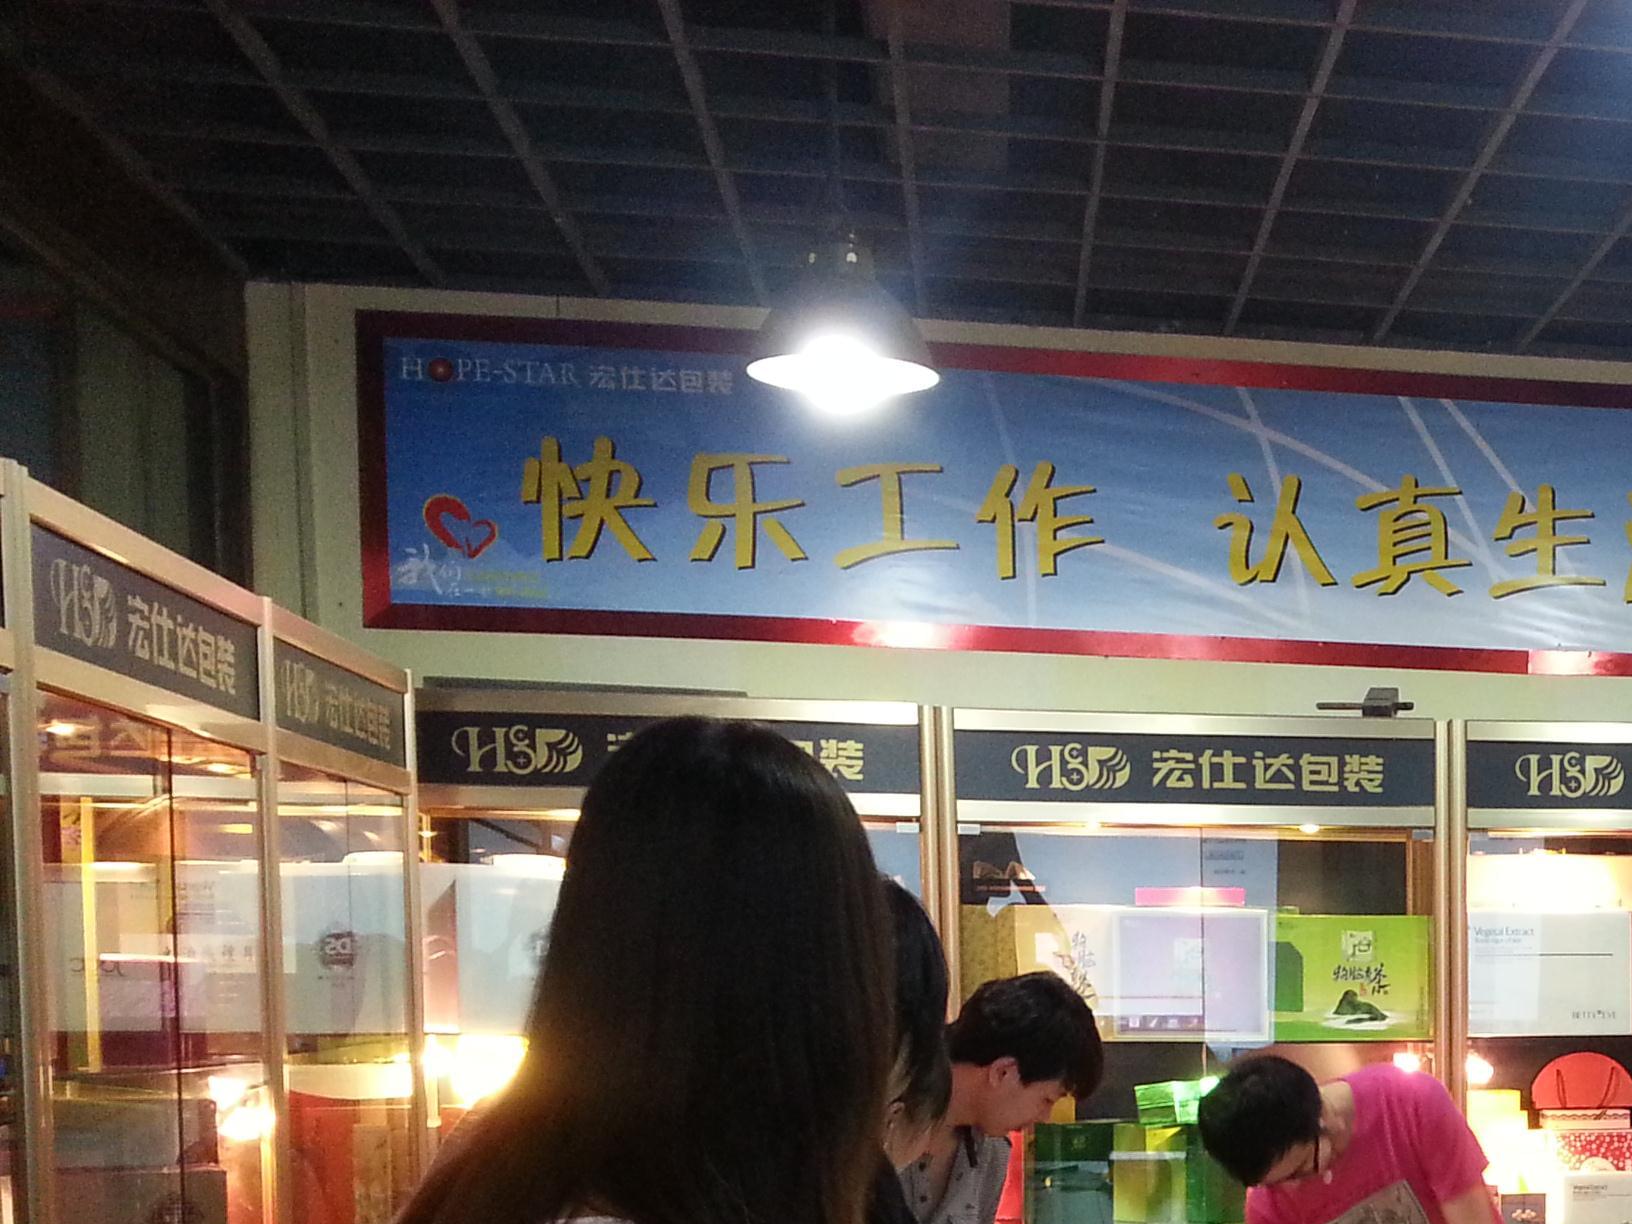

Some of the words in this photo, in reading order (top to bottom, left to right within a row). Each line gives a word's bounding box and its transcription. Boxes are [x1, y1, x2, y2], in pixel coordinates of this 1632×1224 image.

[589, 365, 734, 394] 宏仕达包装
[521, 436, 1105, 580] 快乐工作
[127, 594, 236, 695] 宏仕达包装
[1151, 750, 1385, 794] 宏仕达包装
